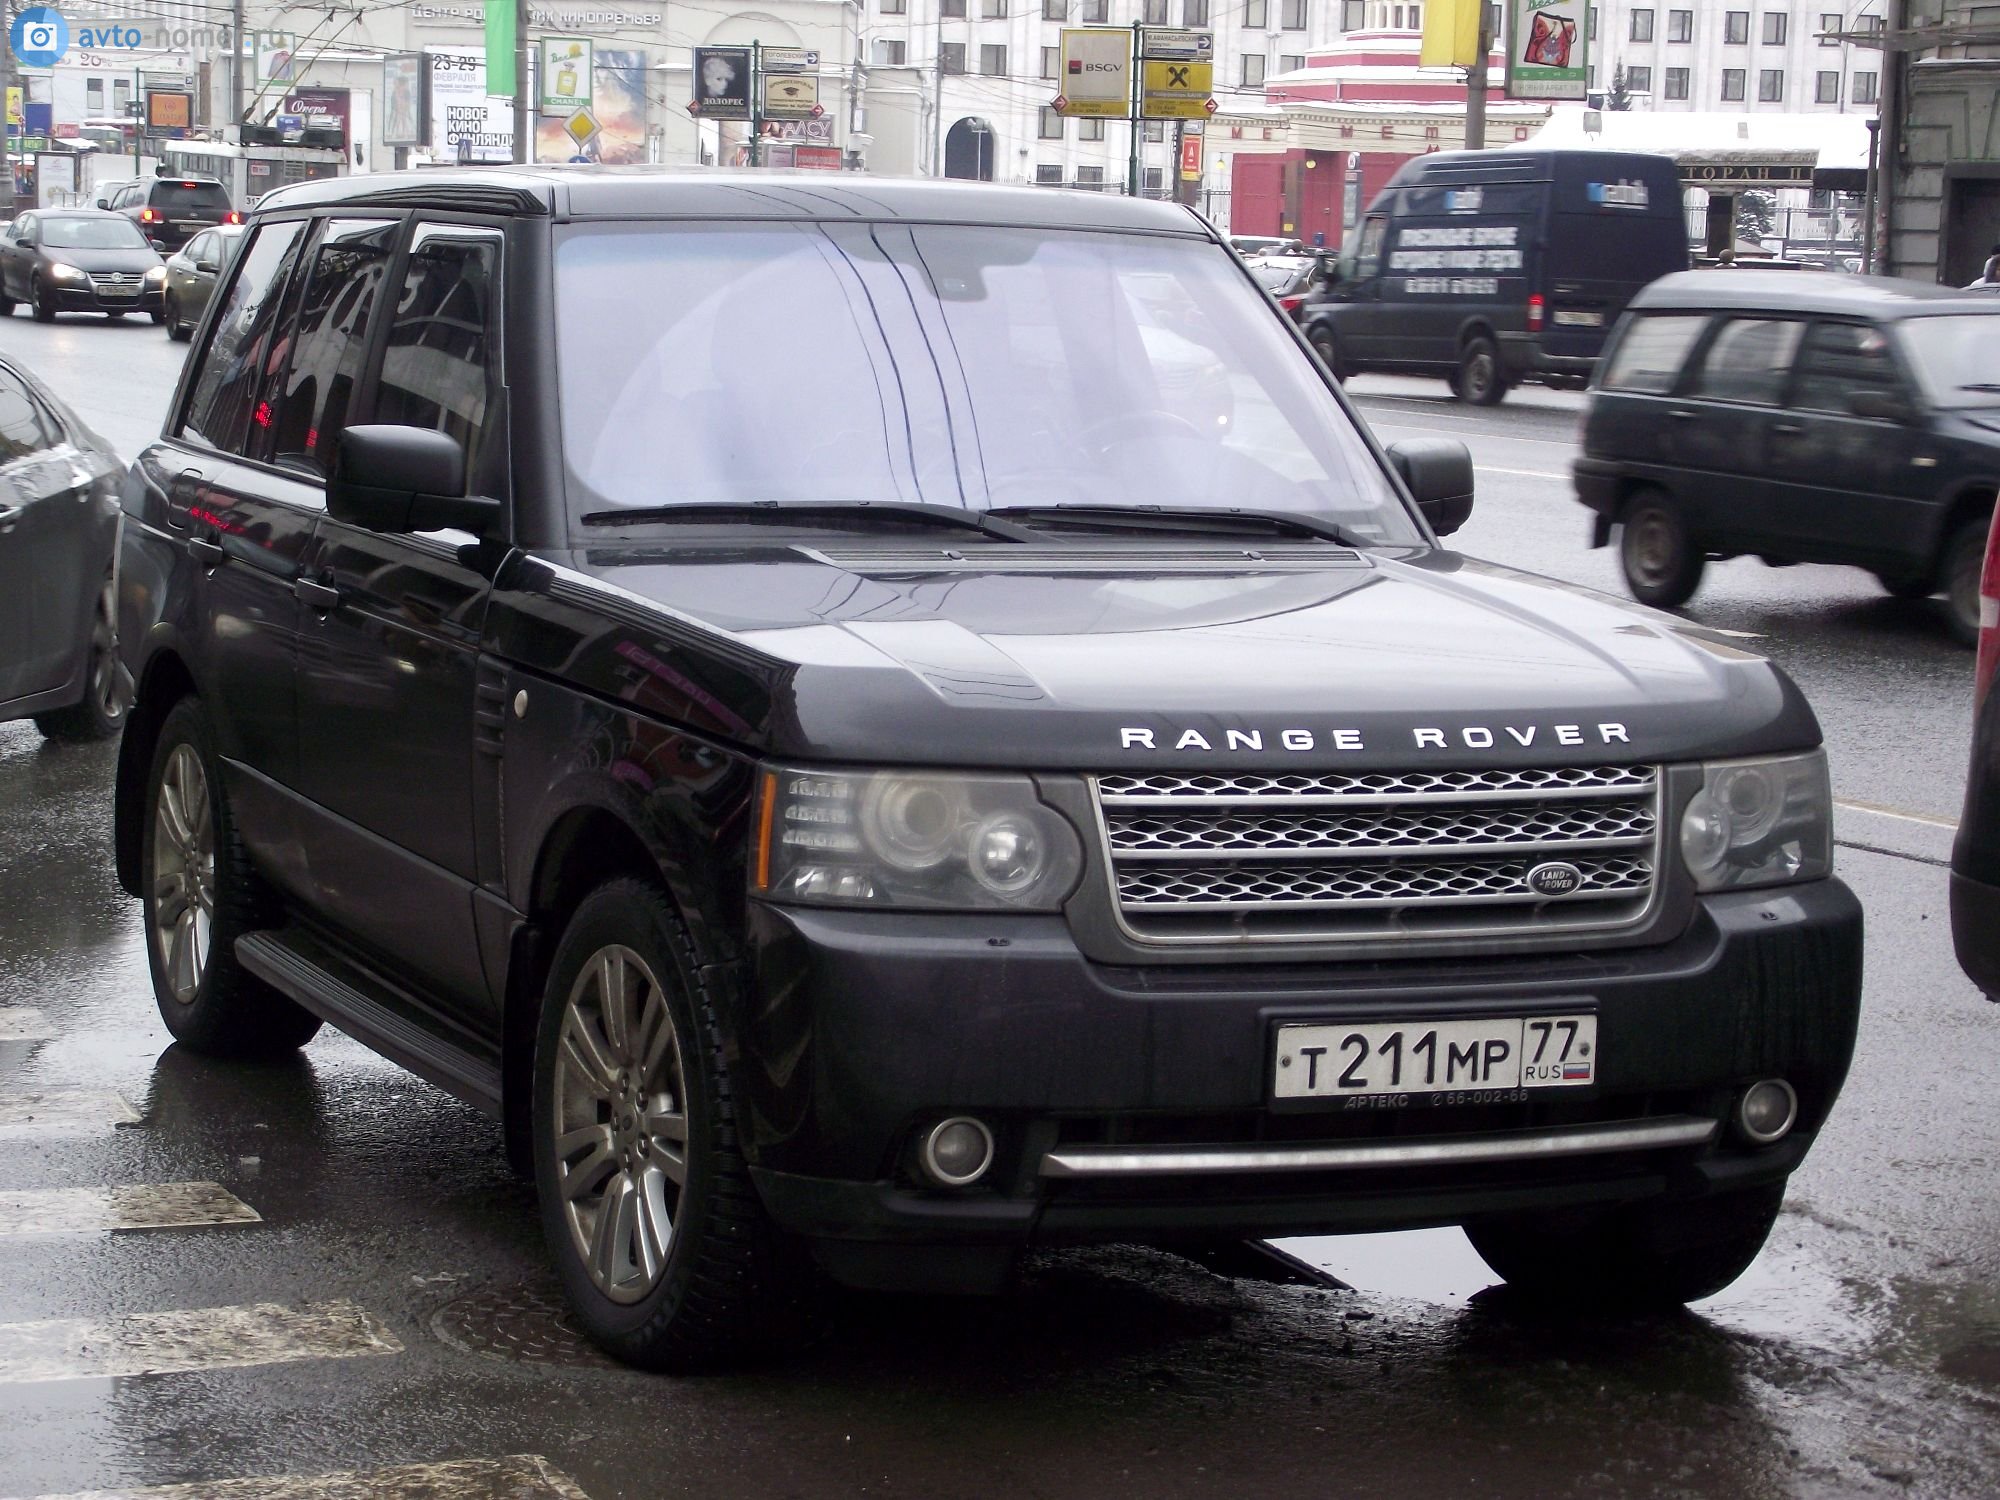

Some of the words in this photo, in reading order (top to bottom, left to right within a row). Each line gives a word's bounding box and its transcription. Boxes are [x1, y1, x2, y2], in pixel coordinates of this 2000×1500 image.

[412, 6, 460, 18] ЦЕНТР
[560, 12, 661, 25] КИНОПРЕМЬЕР
[433, 55, 477, 71] 23-29
[1085, 63, 1123, 73] BSGV
[434, 72, 476, 82] ФЕВРАЛЯ
[291, 100, 327, 114] Опера
[550, 98, 585, 106] CHANEL
[703, 97, 745, 106] ДОЛОРЕС
[447, 106, 488, 120] НОВОЕ
[447, 120, 481, 133] КИНО
[1119, 726, 1365, 752] RANGE
[1413, 723, 1632, 749] ROVER
[1542, 871, 1566, 880] LAND
[1545, 880, 1573, 888] ROVER
[1529, 1020, 1579, 1063] 77
[1525, 1065, 1561, 1081] RUS
[1345, 1094, 1409, 1109] АРТЕКС
